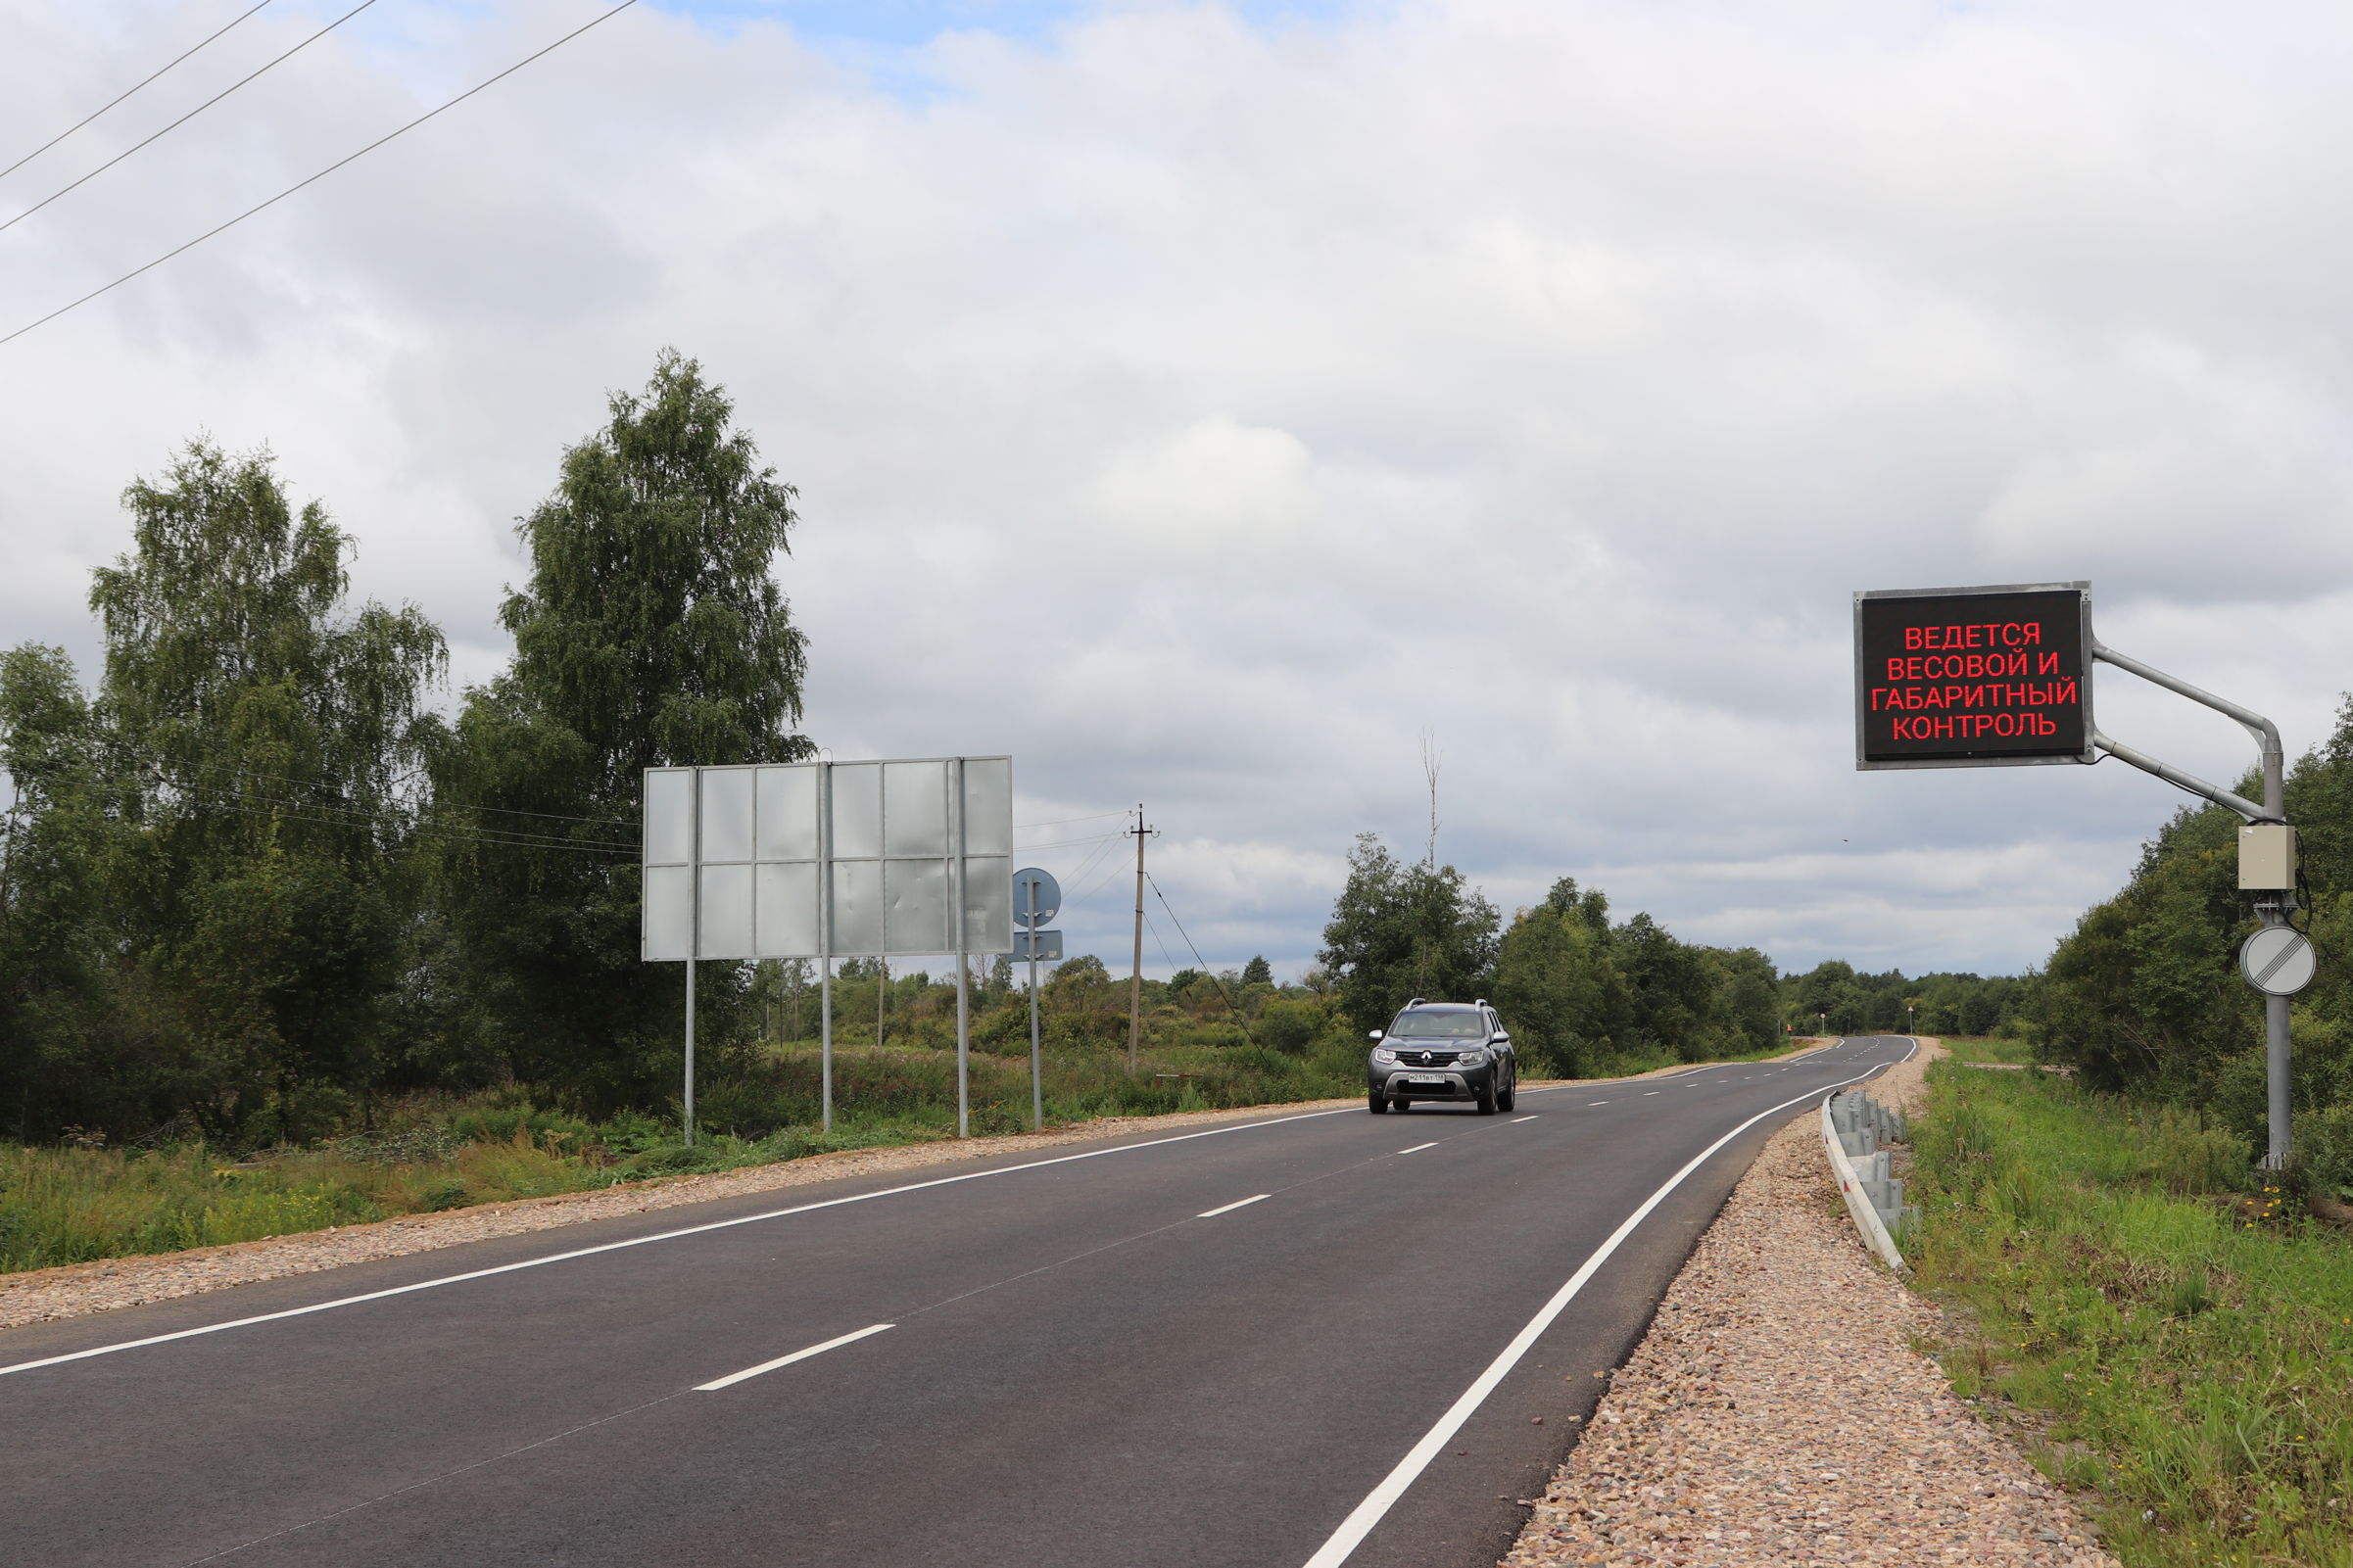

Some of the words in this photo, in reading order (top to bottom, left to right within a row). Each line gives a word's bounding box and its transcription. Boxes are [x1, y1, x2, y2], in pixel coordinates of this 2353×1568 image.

[1905, 622, 2041, 649] ВЕДЕТСЯ
[1887, 648, 2028, 681] ВЕСОВОЙ
[2039, 651, 2058, 675] И
[1872, 676, 2077, 711] ГАБАРИТНЫЙ
[1893, 712, 2056, 739] КОНТРОЛЬ
